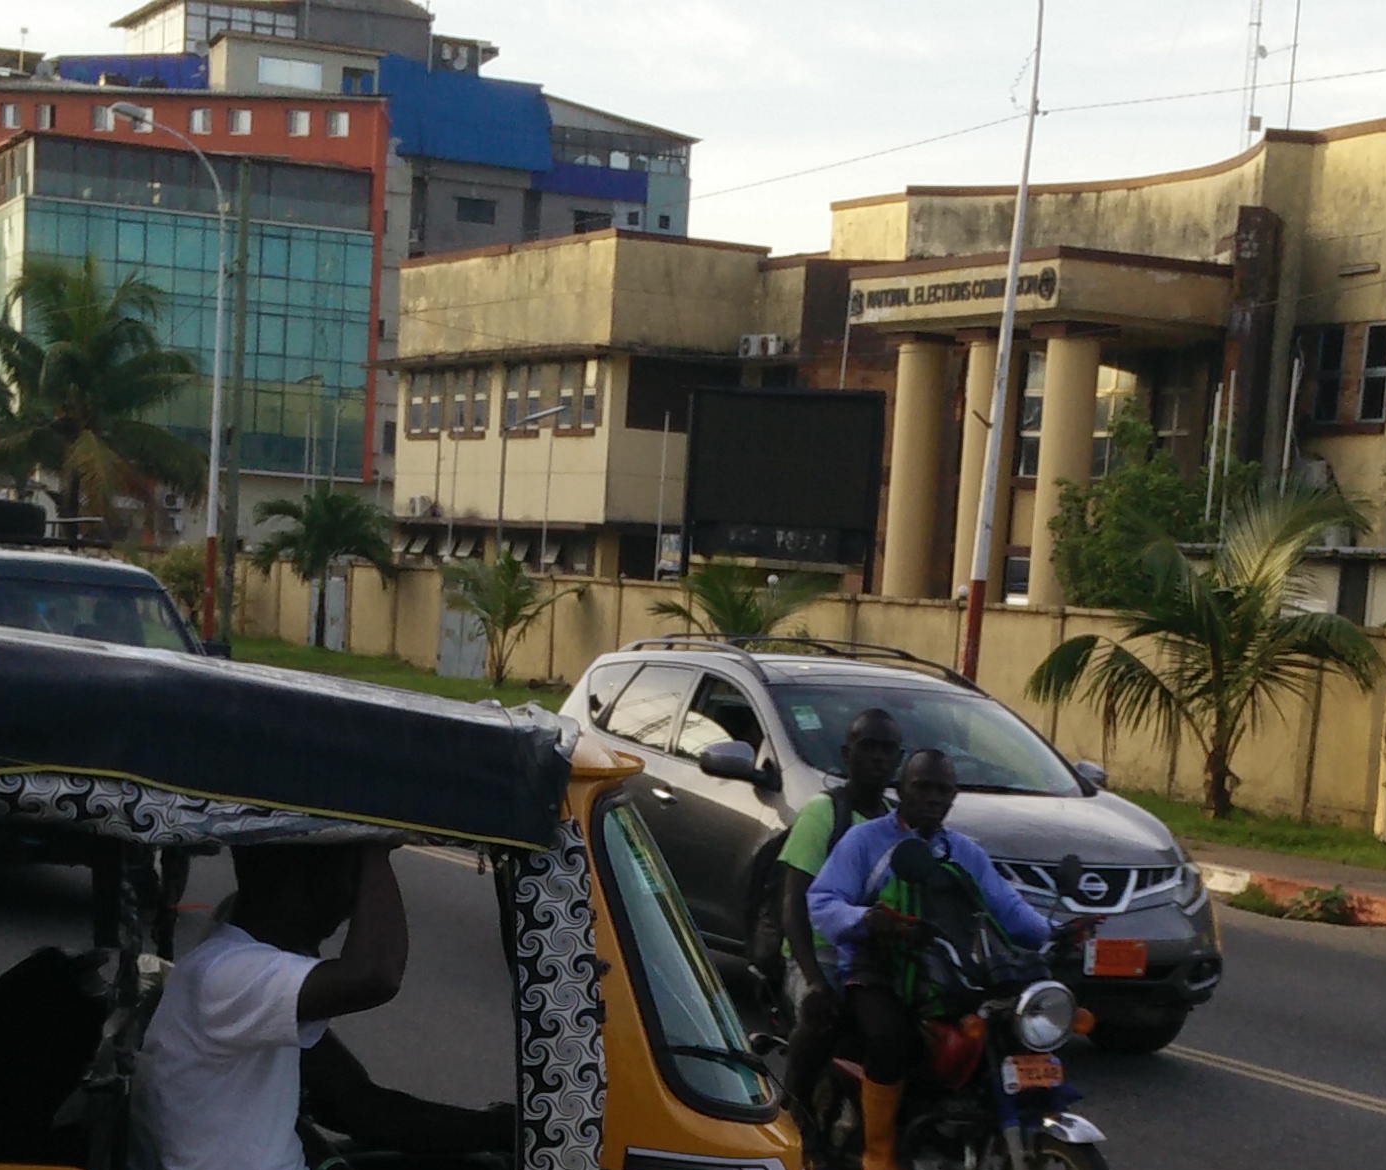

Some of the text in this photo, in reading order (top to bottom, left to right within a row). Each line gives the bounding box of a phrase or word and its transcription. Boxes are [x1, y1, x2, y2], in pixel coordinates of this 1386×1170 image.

[867, 275, 1039, 309] NATIONAL ELECTIONS COMMIION
